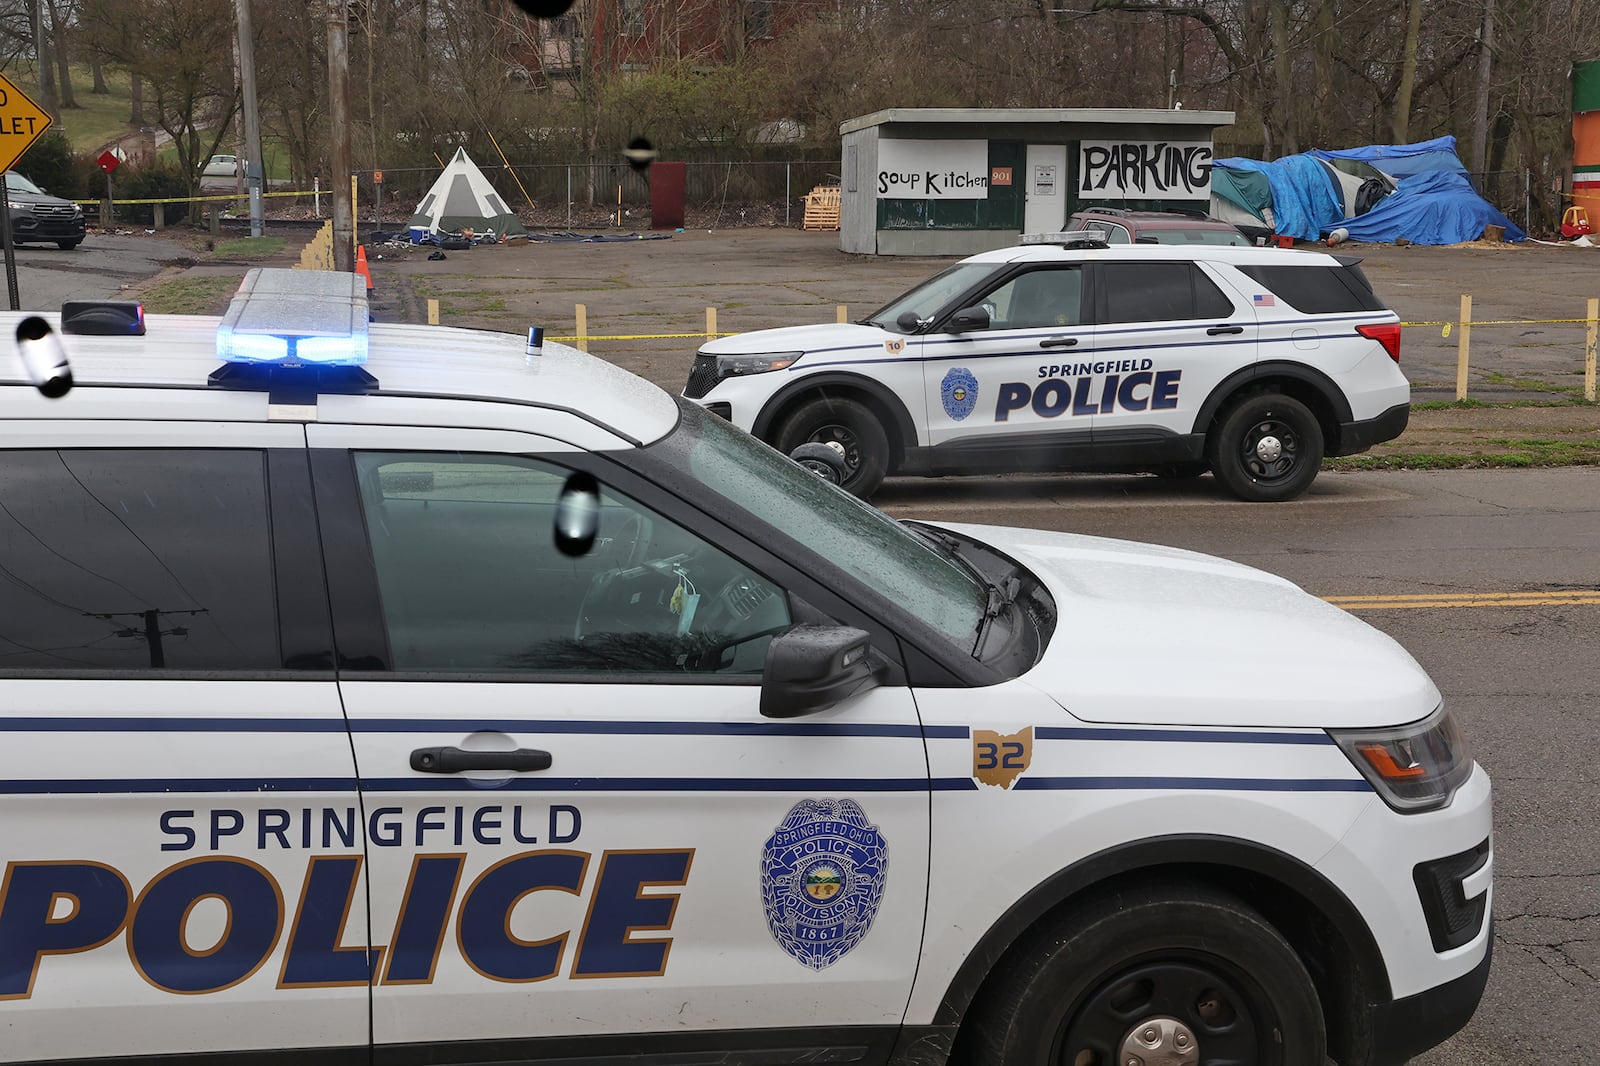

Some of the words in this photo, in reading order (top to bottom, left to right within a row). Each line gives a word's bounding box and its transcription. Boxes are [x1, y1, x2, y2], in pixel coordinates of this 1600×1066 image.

[0, 117, 36, 134] LET
[992, 171, 1010, 181] 901
[1082, 143, 1213, 194] PARKING
[925, 171, 988, 195] Kitchen
[888, 342, 901, 351] 10
[1038, 358, 1153, 378] SPRINGFIELD
[994, 369, 1183, 423] POLICE
[977, 742, 1025, 769] 32
[160, 804, 582, 852] SPRINGFIELD
[776, 822, 847, 846] SPRINGFIELD
[849, 829, 874, 845] OHIO
[792, 839, 857, 859] POLICE
[786, 896, 856, 919] DIVISION
[0, 848, 697, 1000] POLICE
[801, 927, 837, 941] 1867
